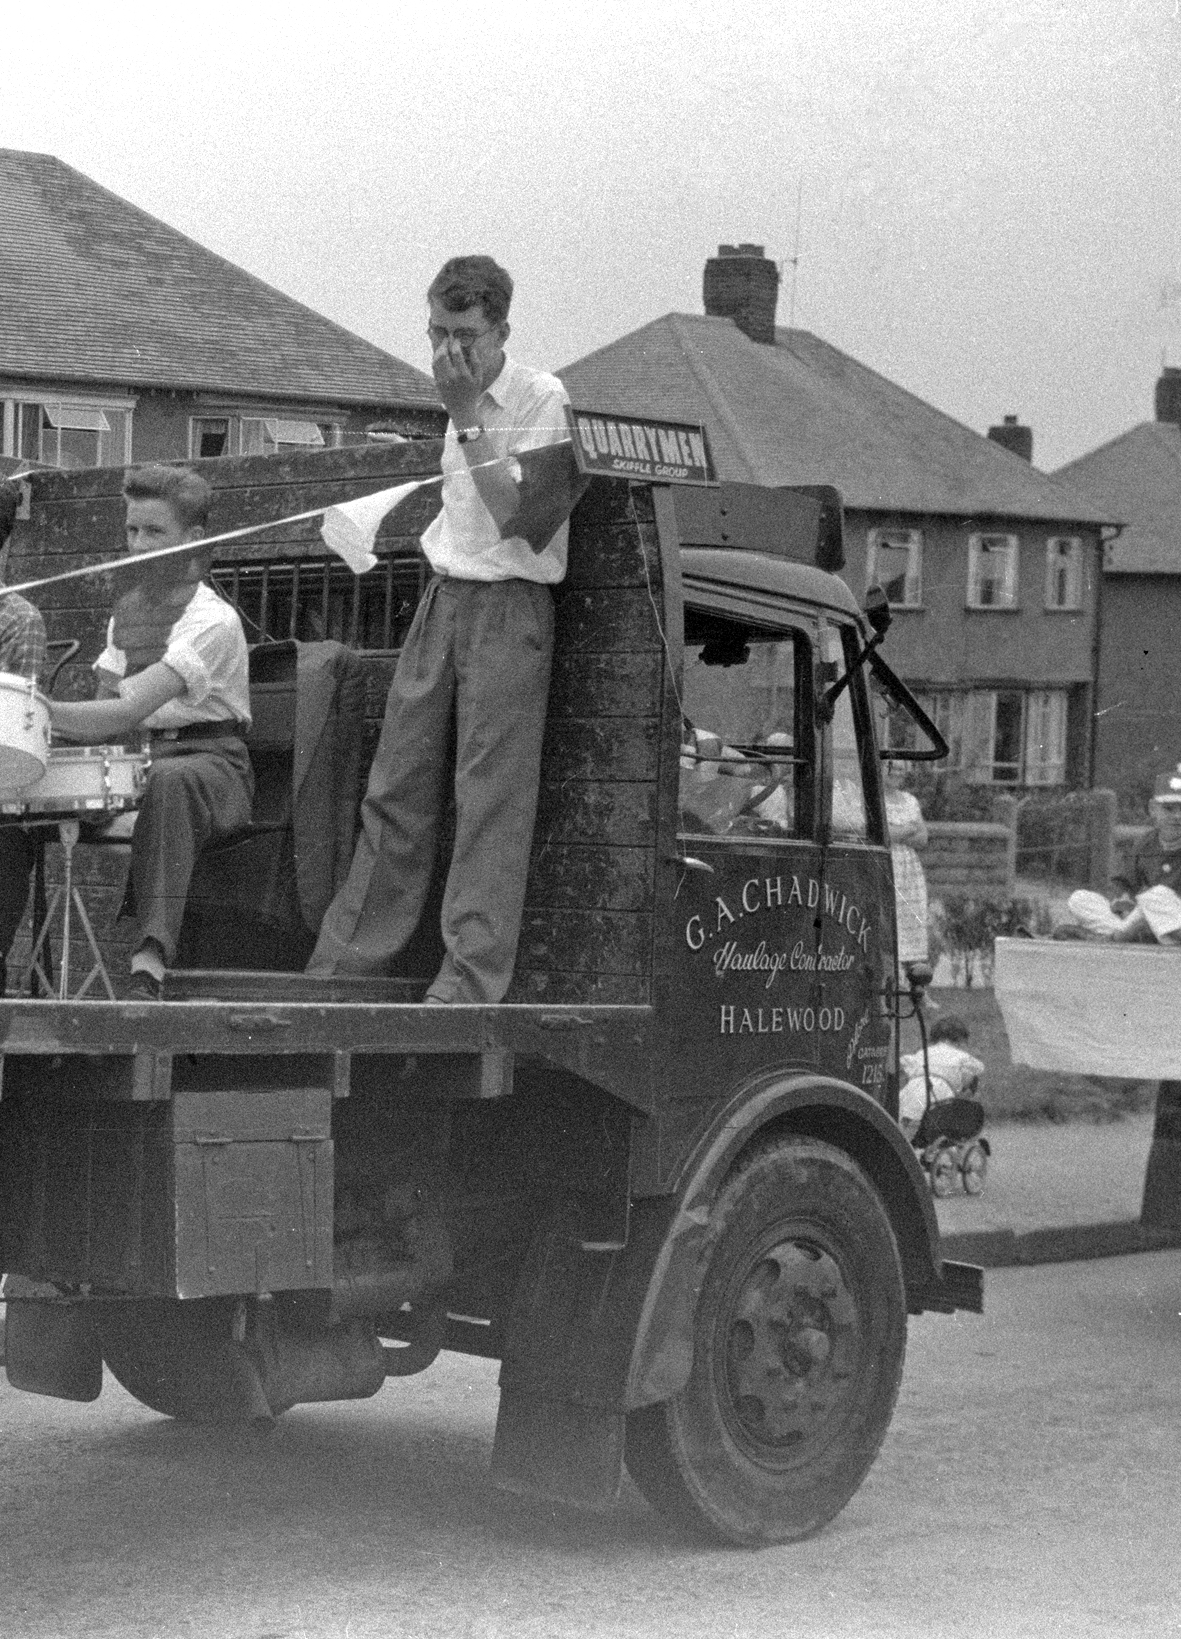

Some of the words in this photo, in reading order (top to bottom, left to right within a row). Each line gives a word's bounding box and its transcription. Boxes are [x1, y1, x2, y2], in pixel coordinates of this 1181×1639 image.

[577, 417, 708, 468] QUARRYMEN
[612, 459, 652, 474] SKIFFLE
[654, 464, 689, 478] GROUP
[713, 941, 787, 989] Haulage
[720, 1005, 845, 1033] HALEWOOD
